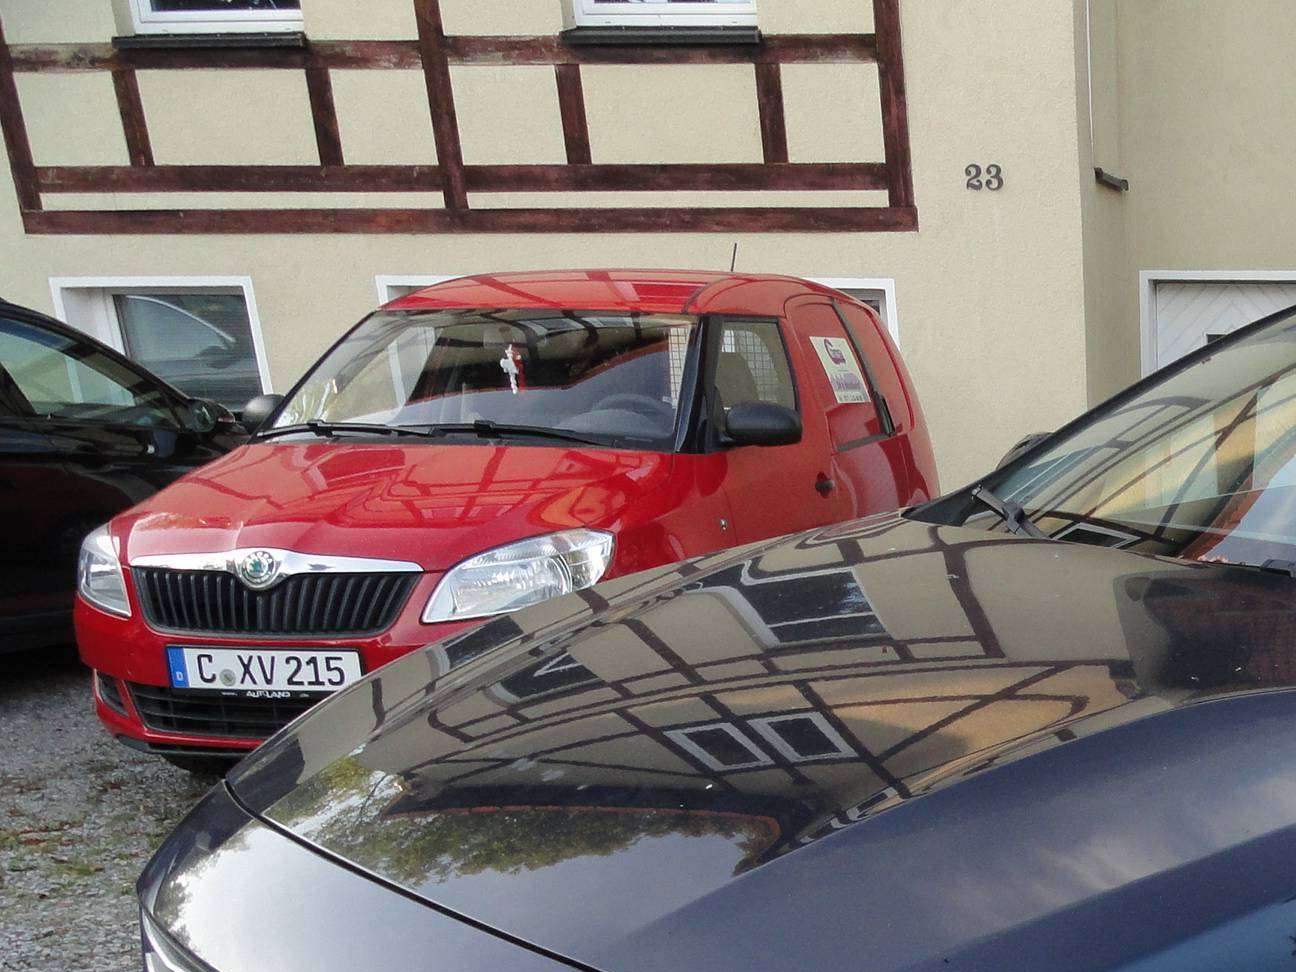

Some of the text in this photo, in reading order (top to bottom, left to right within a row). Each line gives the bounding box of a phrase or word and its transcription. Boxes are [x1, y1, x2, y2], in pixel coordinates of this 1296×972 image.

[965, 163, 1004, 191] 23
[175, 654, 346, 687] D C XV 215
